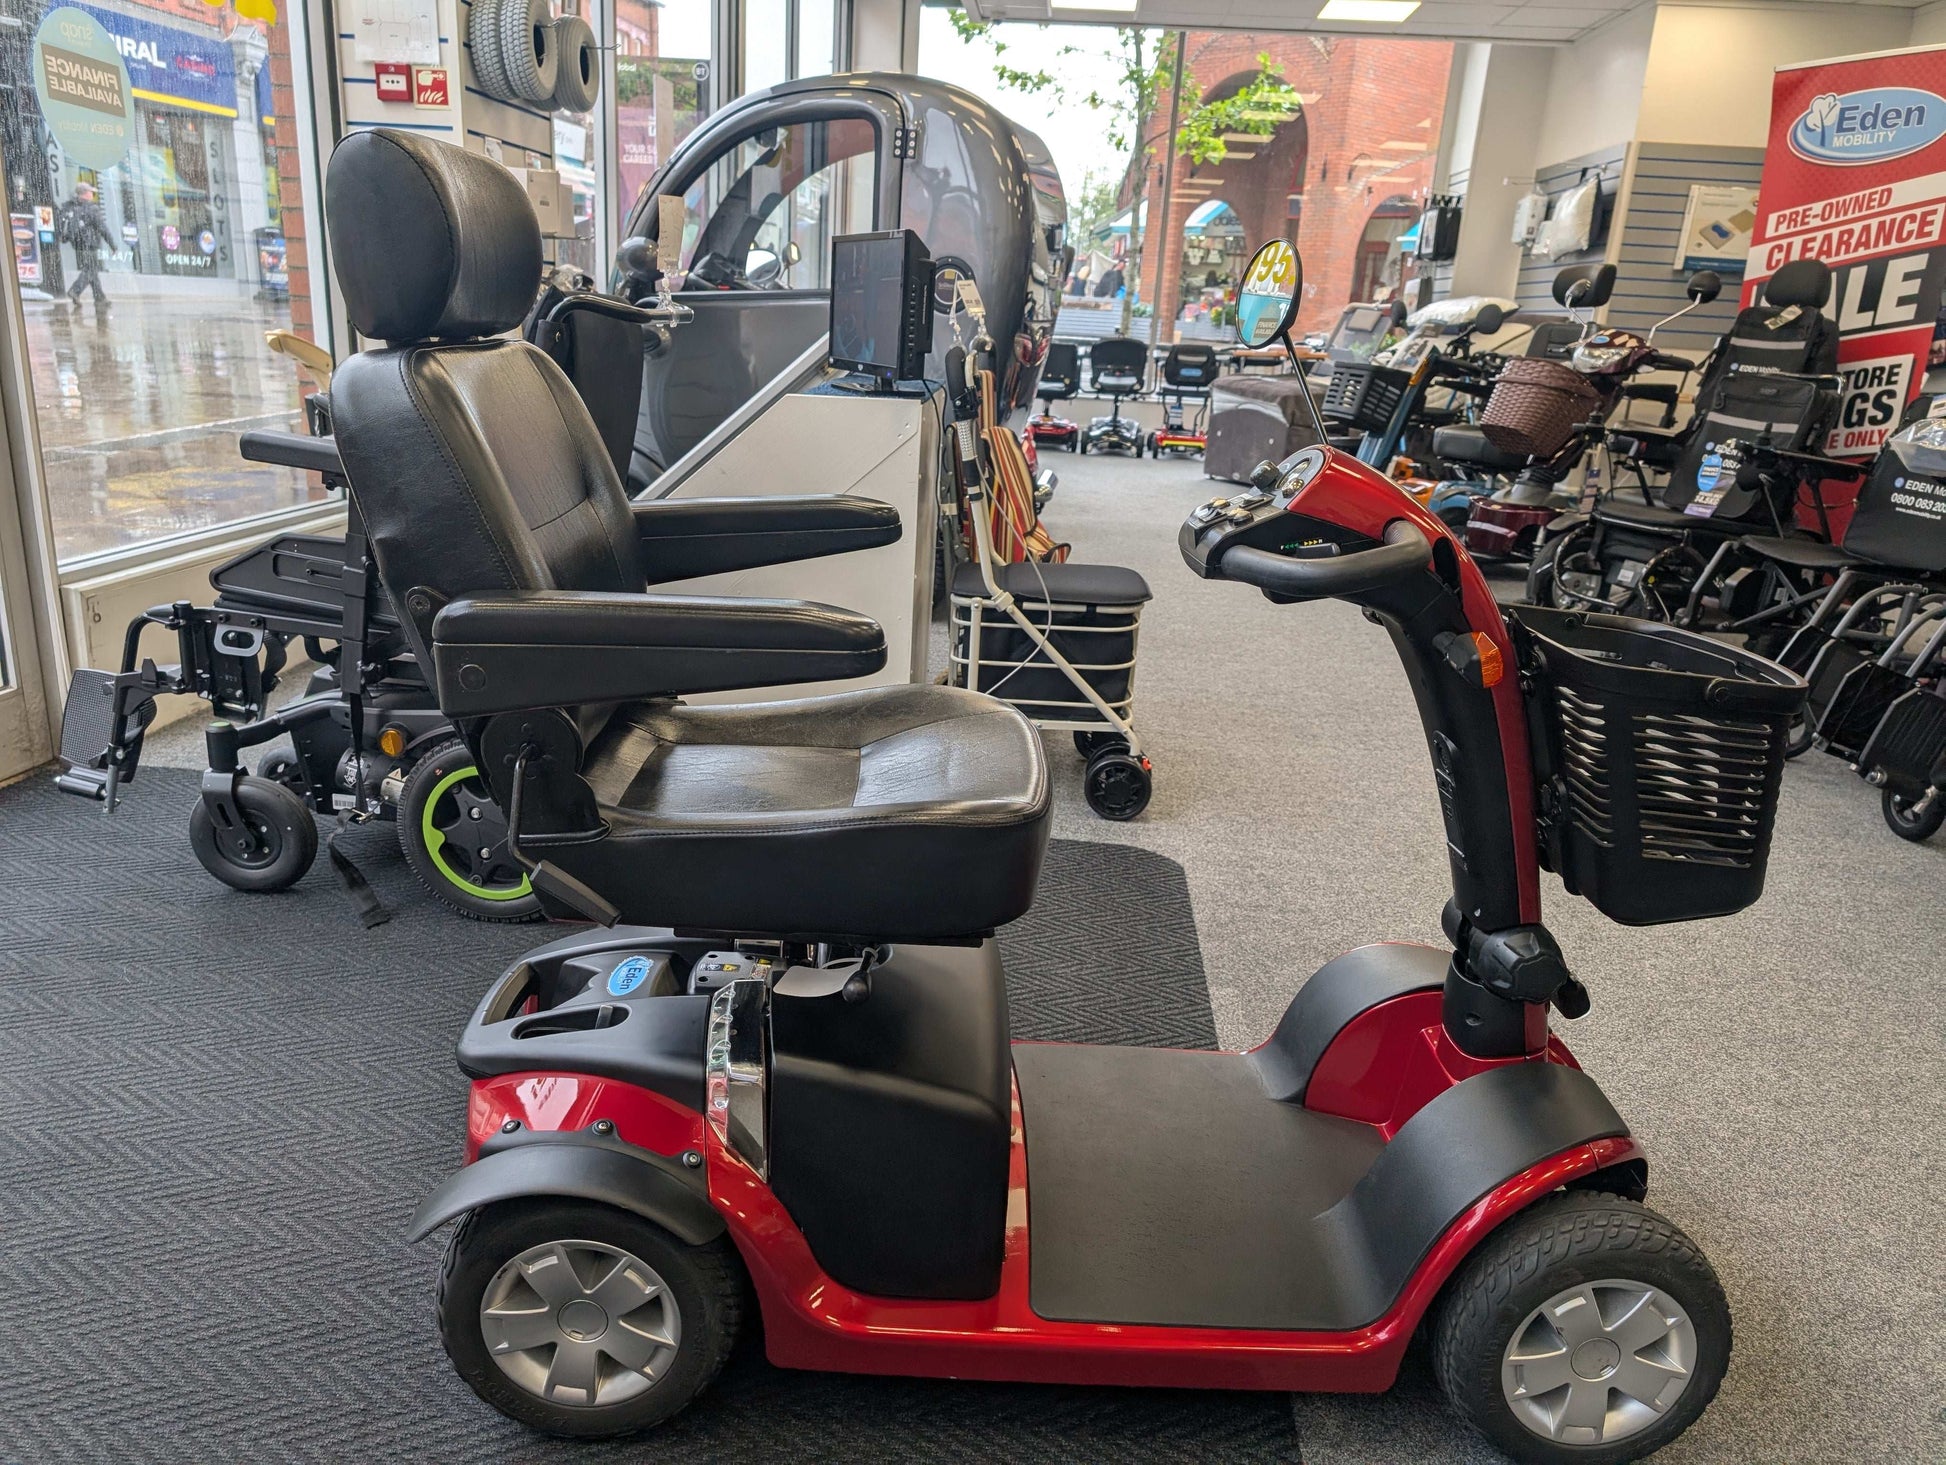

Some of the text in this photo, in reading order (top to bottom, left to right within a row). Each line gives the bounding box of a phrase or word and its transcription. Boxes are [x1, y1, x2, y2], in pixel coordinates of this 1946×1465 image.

[1835, 102, 1927, 134] Eden
[1832, 130, 1898, 148] MOBILITY
[1774, 187, 1893, 232] PRE-OWNED
[1765, 208, 1939, 271] CLEARANCE
[165, 253, 211, 267] OPEN 24/7
[1843, 428, 1890, 448] ONLY
[1905, 480, 1934, 493] EDEN
[1890, 492, 1916, 506] 0800
[1915, 498, 1935, 510] 083
[619, 967, 643, 990] Eden
